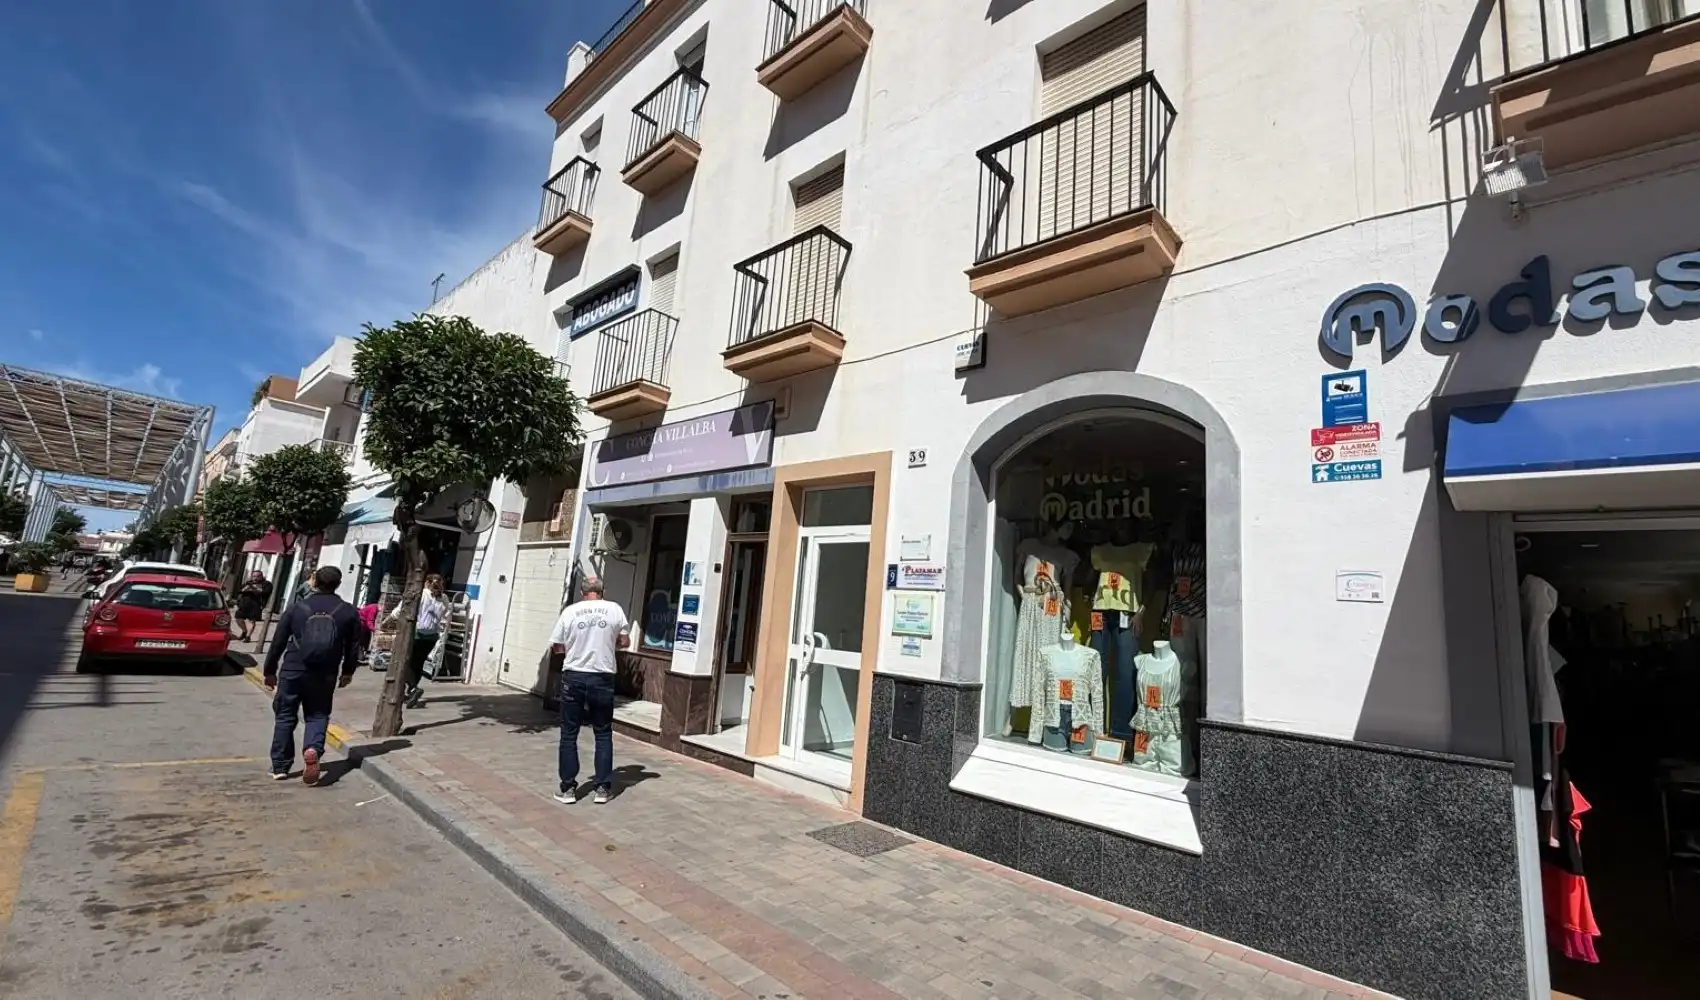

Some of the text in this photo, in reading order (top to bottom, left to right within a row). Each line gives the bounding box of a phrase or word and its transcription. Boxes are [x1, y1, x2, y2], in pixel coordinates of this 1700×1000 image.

[573, 282, 636, 331] ABOGADO
[1321, 253, 1700, 357] Modas
[665, 419, 717, 442] VILLALBA
[1351, 423, 1377, 432] ZONA
[1340, 442, 1377, 451] ALARMA
[909, 450, 926, 463] 39
[1334, 462, 1377, 472] Cuevas
[1040, 487, 1154, 522] Madrid
